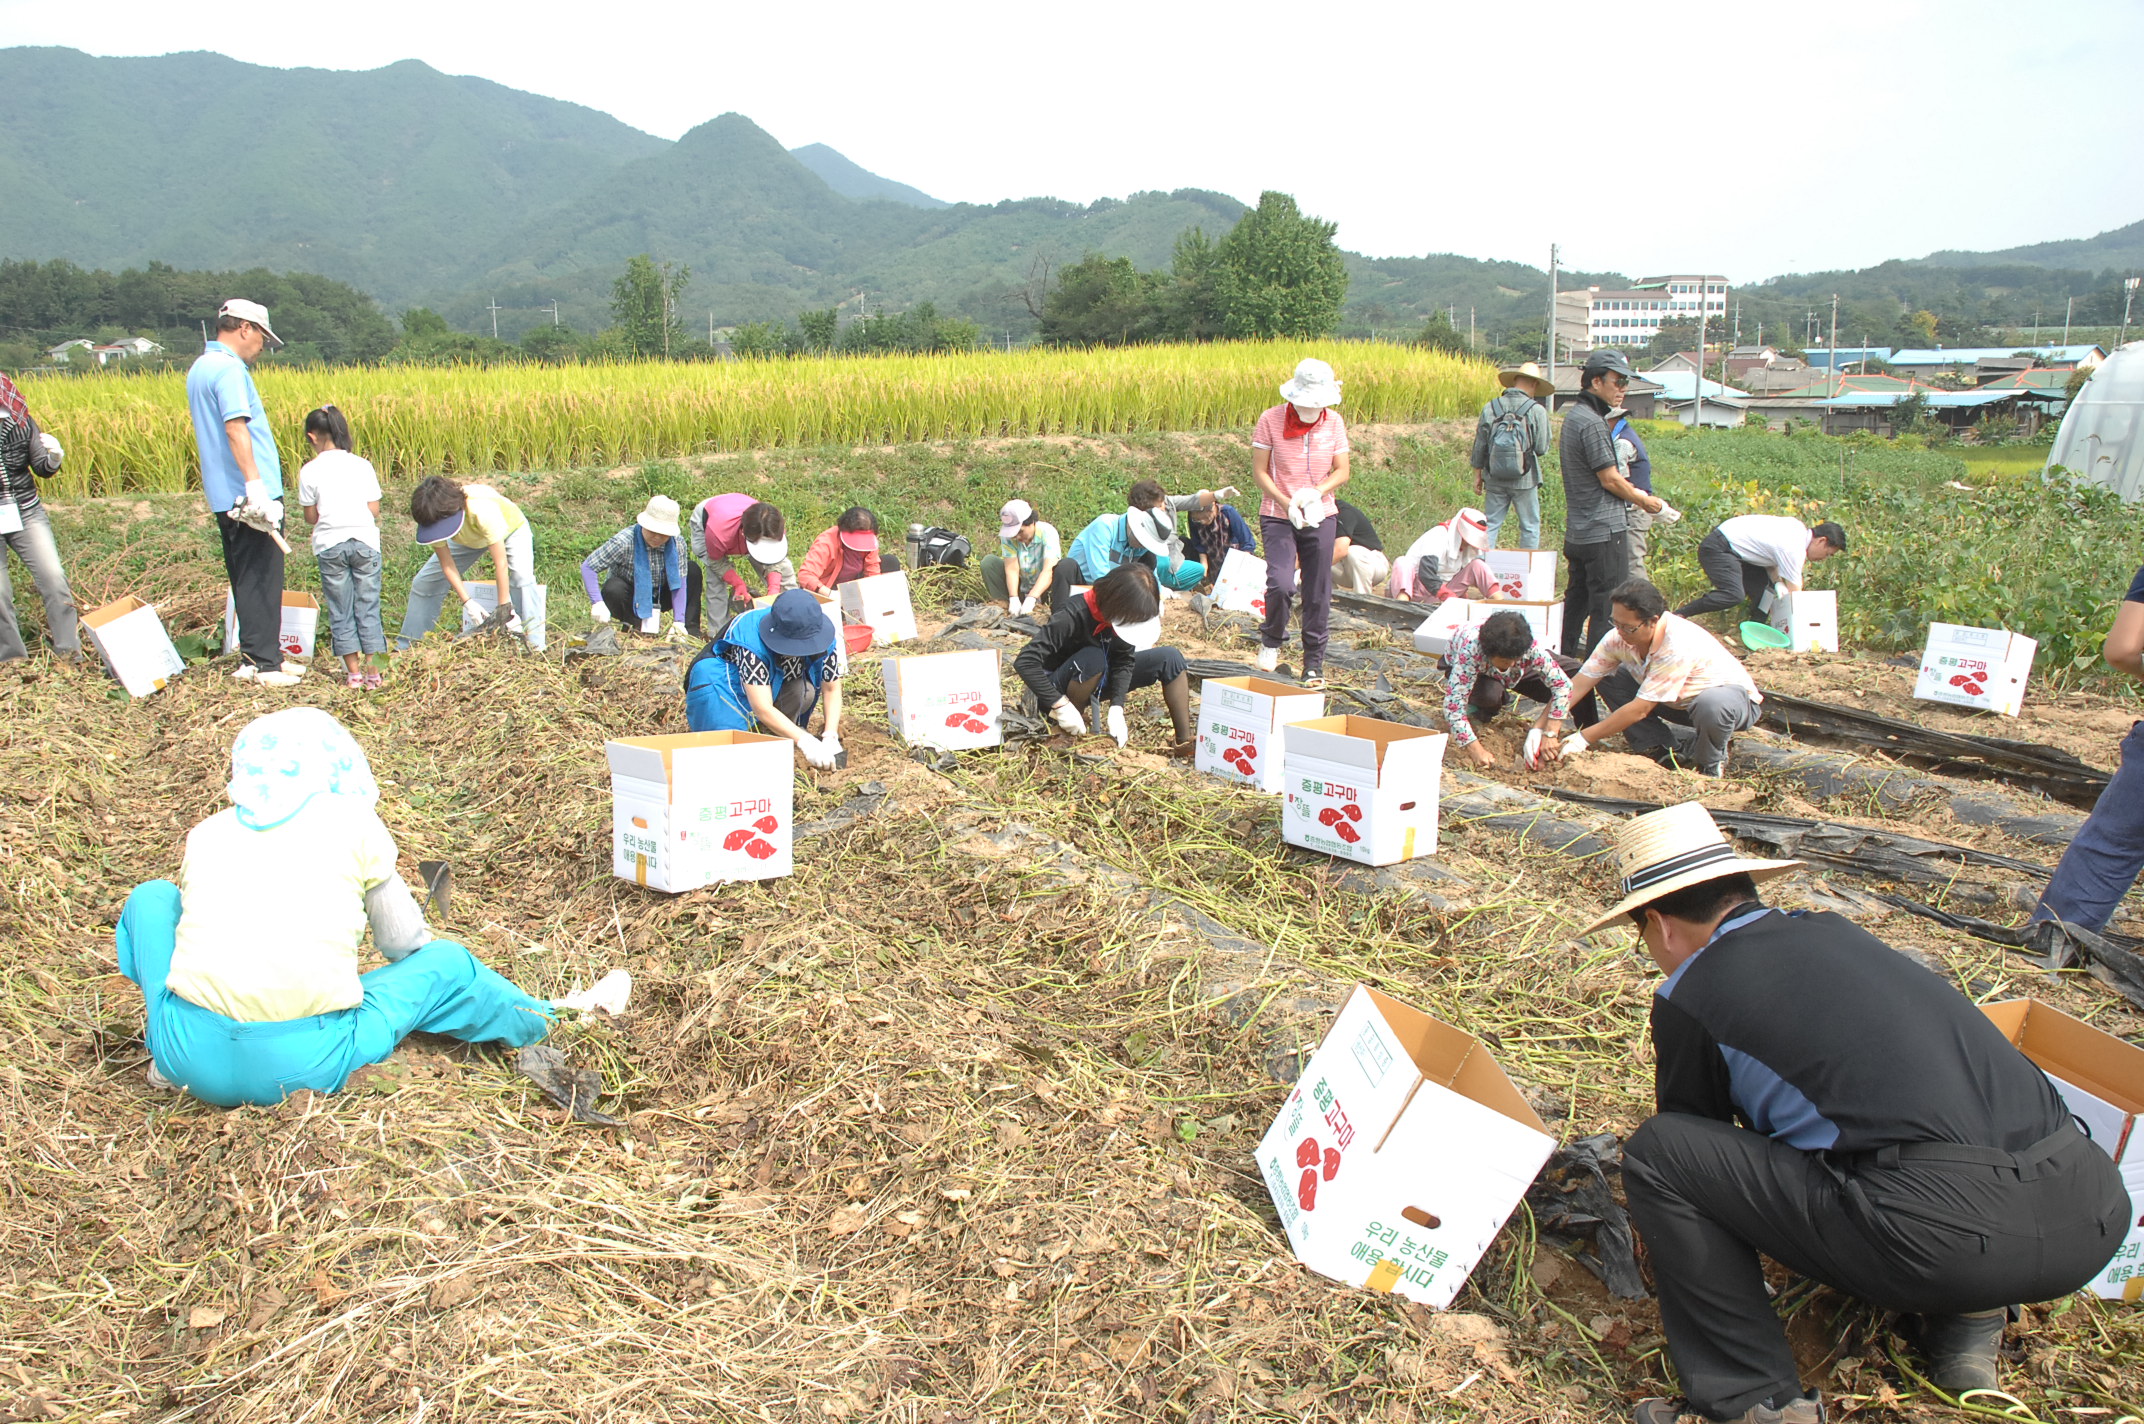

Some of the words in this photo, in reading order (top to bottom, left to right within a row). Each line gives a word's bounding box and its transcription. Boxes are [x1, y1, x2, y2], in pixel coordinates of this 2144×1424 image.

[281, 635, 299, 643] 구마
[1958, 658, 1987, 670] 고구마
[948, 691, 982, 704] 고구마
[1212, 722, 1228, 736] 증평
[1229, 727, 1255, 744] 고구마
[1302, 778, 1323, 795] 증평
[1324, 782, 1358, 802] 고구마
[699, 805, 728, 822] 증평
[729, 798, 771, 818] 고구마
[623, 833, 636, 848] 우리
[638, 837, 657, 854] 농산물
[1313, 1076, 1334, 1112] 증평
[1324, 1099, 1356, 1152] 고구마
[1365, 1221, 1400, 1247] 우리
[1399, 1236, 1449, 1269] 농산물
[2114, 1242, 2140, 1262] 우리
[1350, 1241, 1384, 1266] 애용
[1385, 1257, 1434, 1288] 합시다
[2107, 1264, 2133, 1284] 애용
